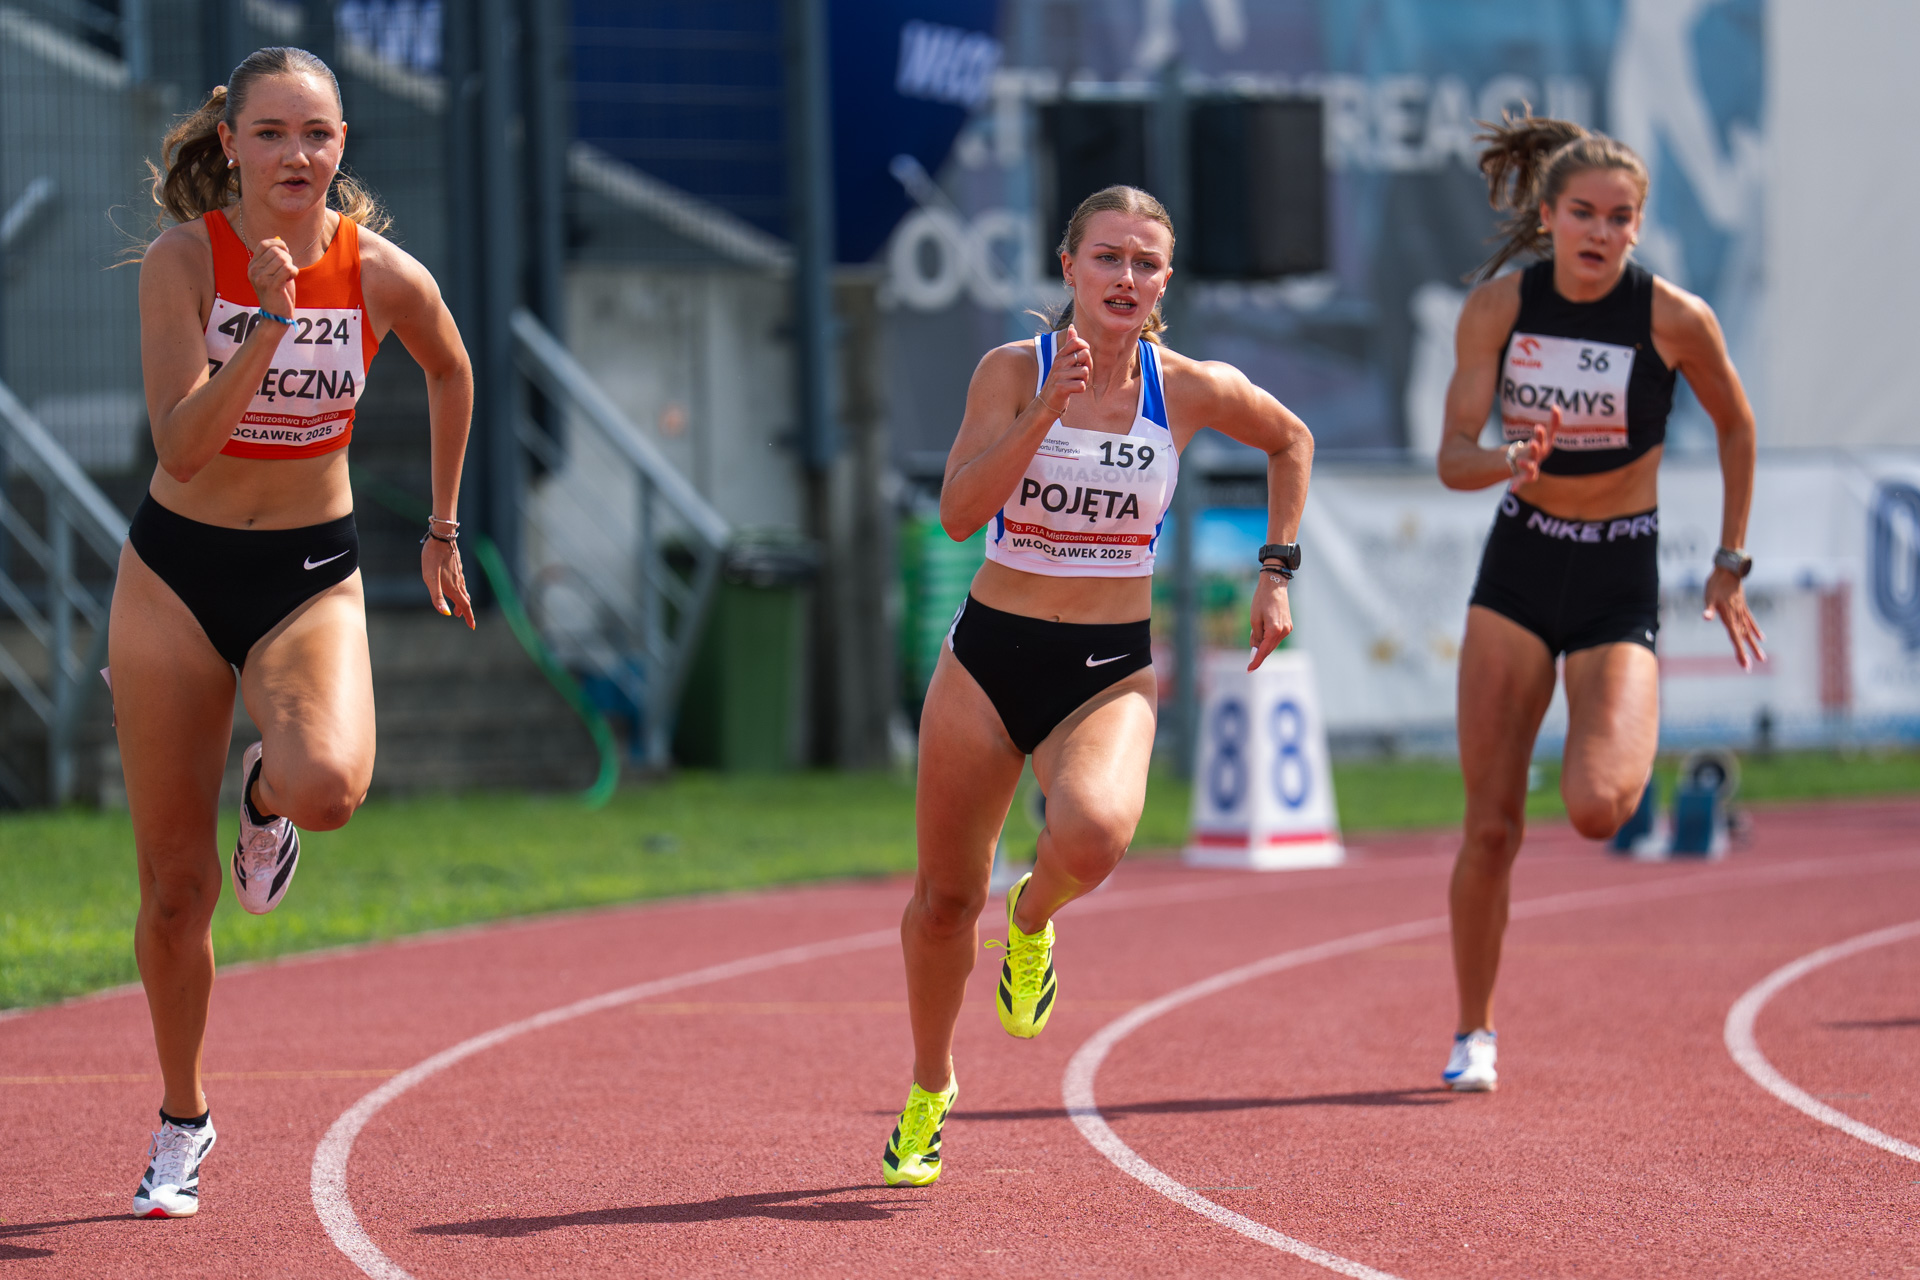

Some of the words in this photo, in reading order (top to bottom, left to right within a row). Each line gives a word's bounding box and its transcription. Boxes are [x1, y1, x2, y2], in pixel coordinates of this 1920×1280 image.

[294, 317, 350, 345] 224
[1577, 348, 1610, 372] 56
[1503, 378, 1616, 417] ROZMYS
[245, 413, 300, 426] Mistrzostwa
[301, 415, 323, 426] Polski
[324, 411, 339, 421] U20
[305, 425, 333, 441] 2025
[1055, 446, 1081, 454] Turystyki
[1099, 440, 1155, 470] 159
[1019, 477, 1140, 523] POJĘTA
[1011, 523, 1024, 532] 79.
[1025, 525, 1045, 535] PZLA
[1045, 531, 1095, 542] Mistrzostwa
[1121, 535, 1138, 543] U20
[1526, 511, 1604, 542] NIKE
[1012, 538, 1097, 559] WŁOCŁAWEK
[1100, 549, 1132, 559] 2025
[1209, 696, 1250, 816] 8
[1268, 696, 1312, 816] 8
